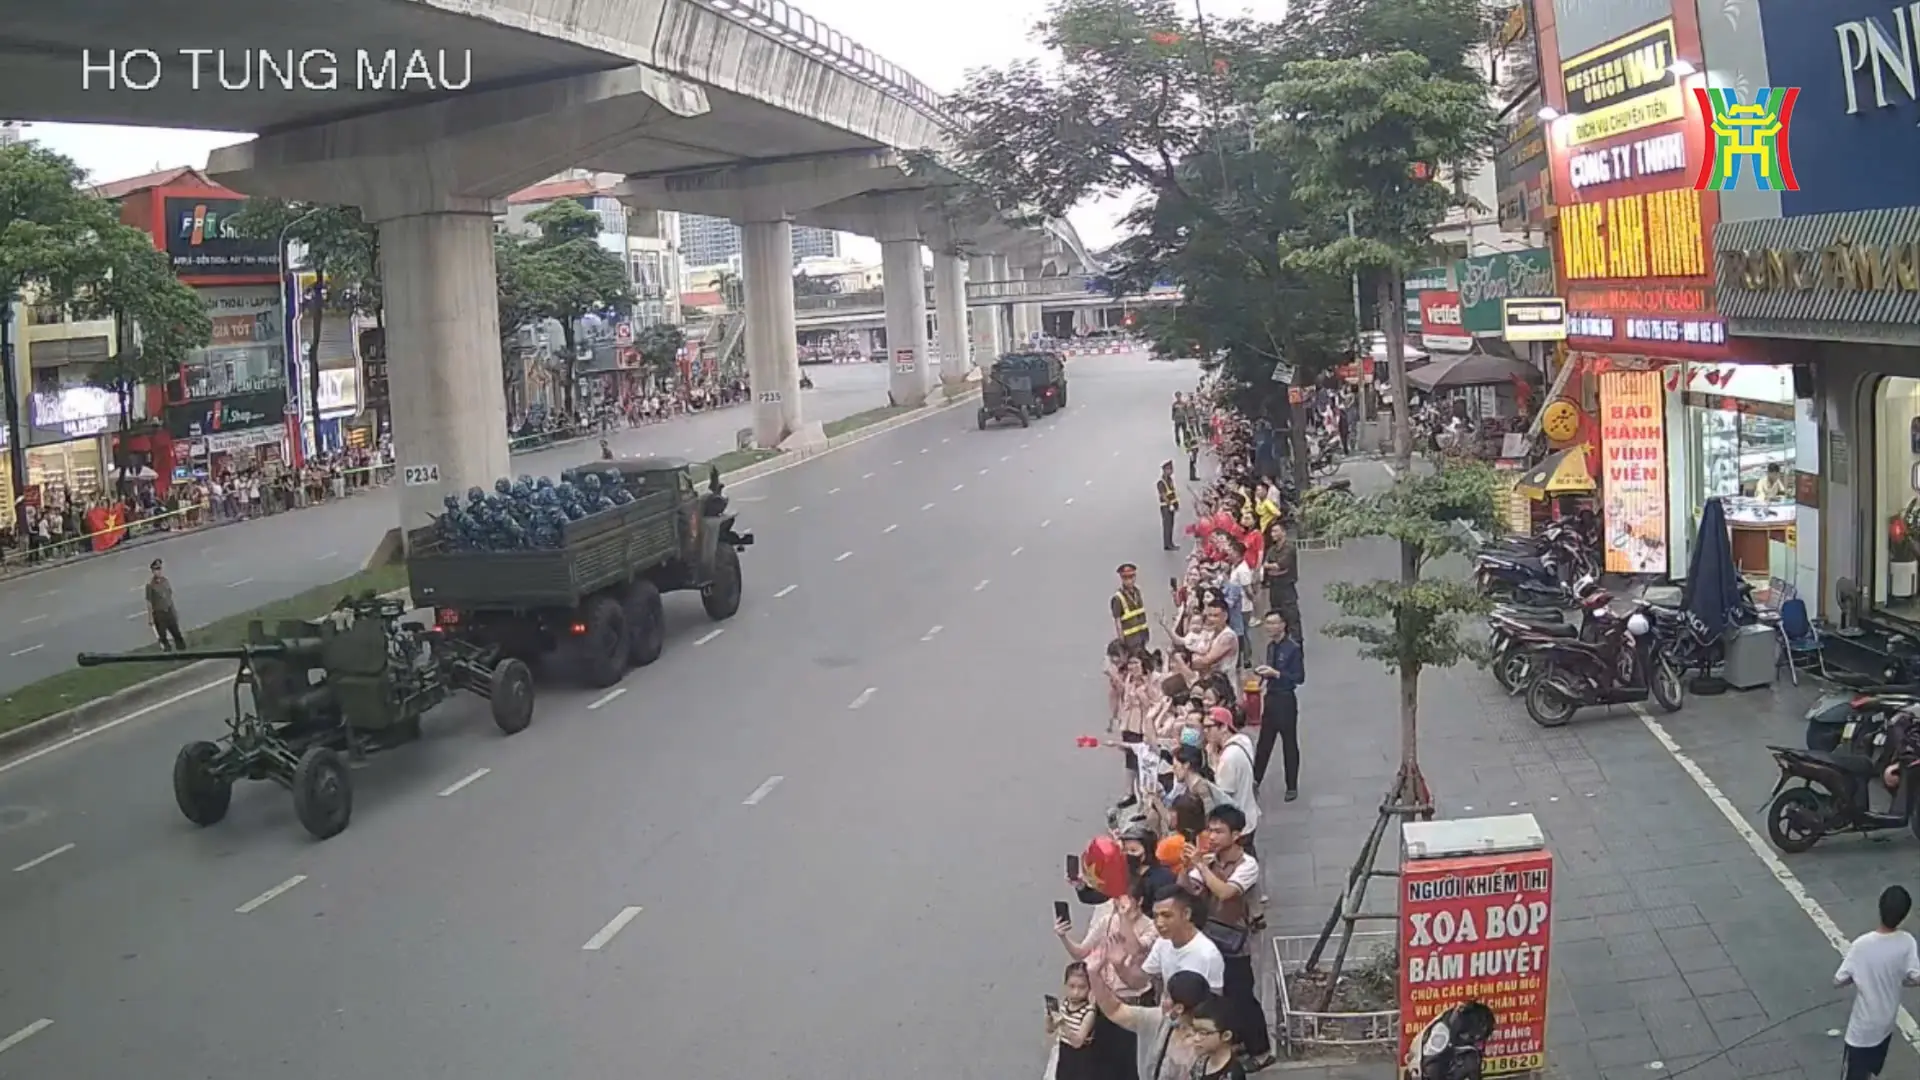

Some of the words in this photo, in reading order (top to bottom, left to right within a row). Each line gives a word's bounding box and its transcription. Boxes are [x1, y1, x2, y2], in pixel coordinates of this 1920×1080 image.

[1565, 57, 1624, 92] WESTERN
[1584, 75, 1625, 103] UNION
[1612, 144, 1632, 179] TY
[1607, 194, 1648, 277] ANH
[405, 467, 439, 483] P234
[1409, 873, 1461, 901] NGƯỜI
[1464, 867, 1518, 897] KHIẾM
[1521, 868, 1548, 893] THỊ
[1409, 909, 1479, 946] XOA
[1485, 893, 1547, 939] BÓP
[1409, 945, 1463, 983] BẤM
[1470, 941, 1545, 978] HUYỆT
[1415, 1004, 1433, 1017] VAI
[1487, 994, 1517, 1010] CHÂN
[1442, 985, 1464, 998] CÁC
[1466, 982, 1494, 997] BỆNH
